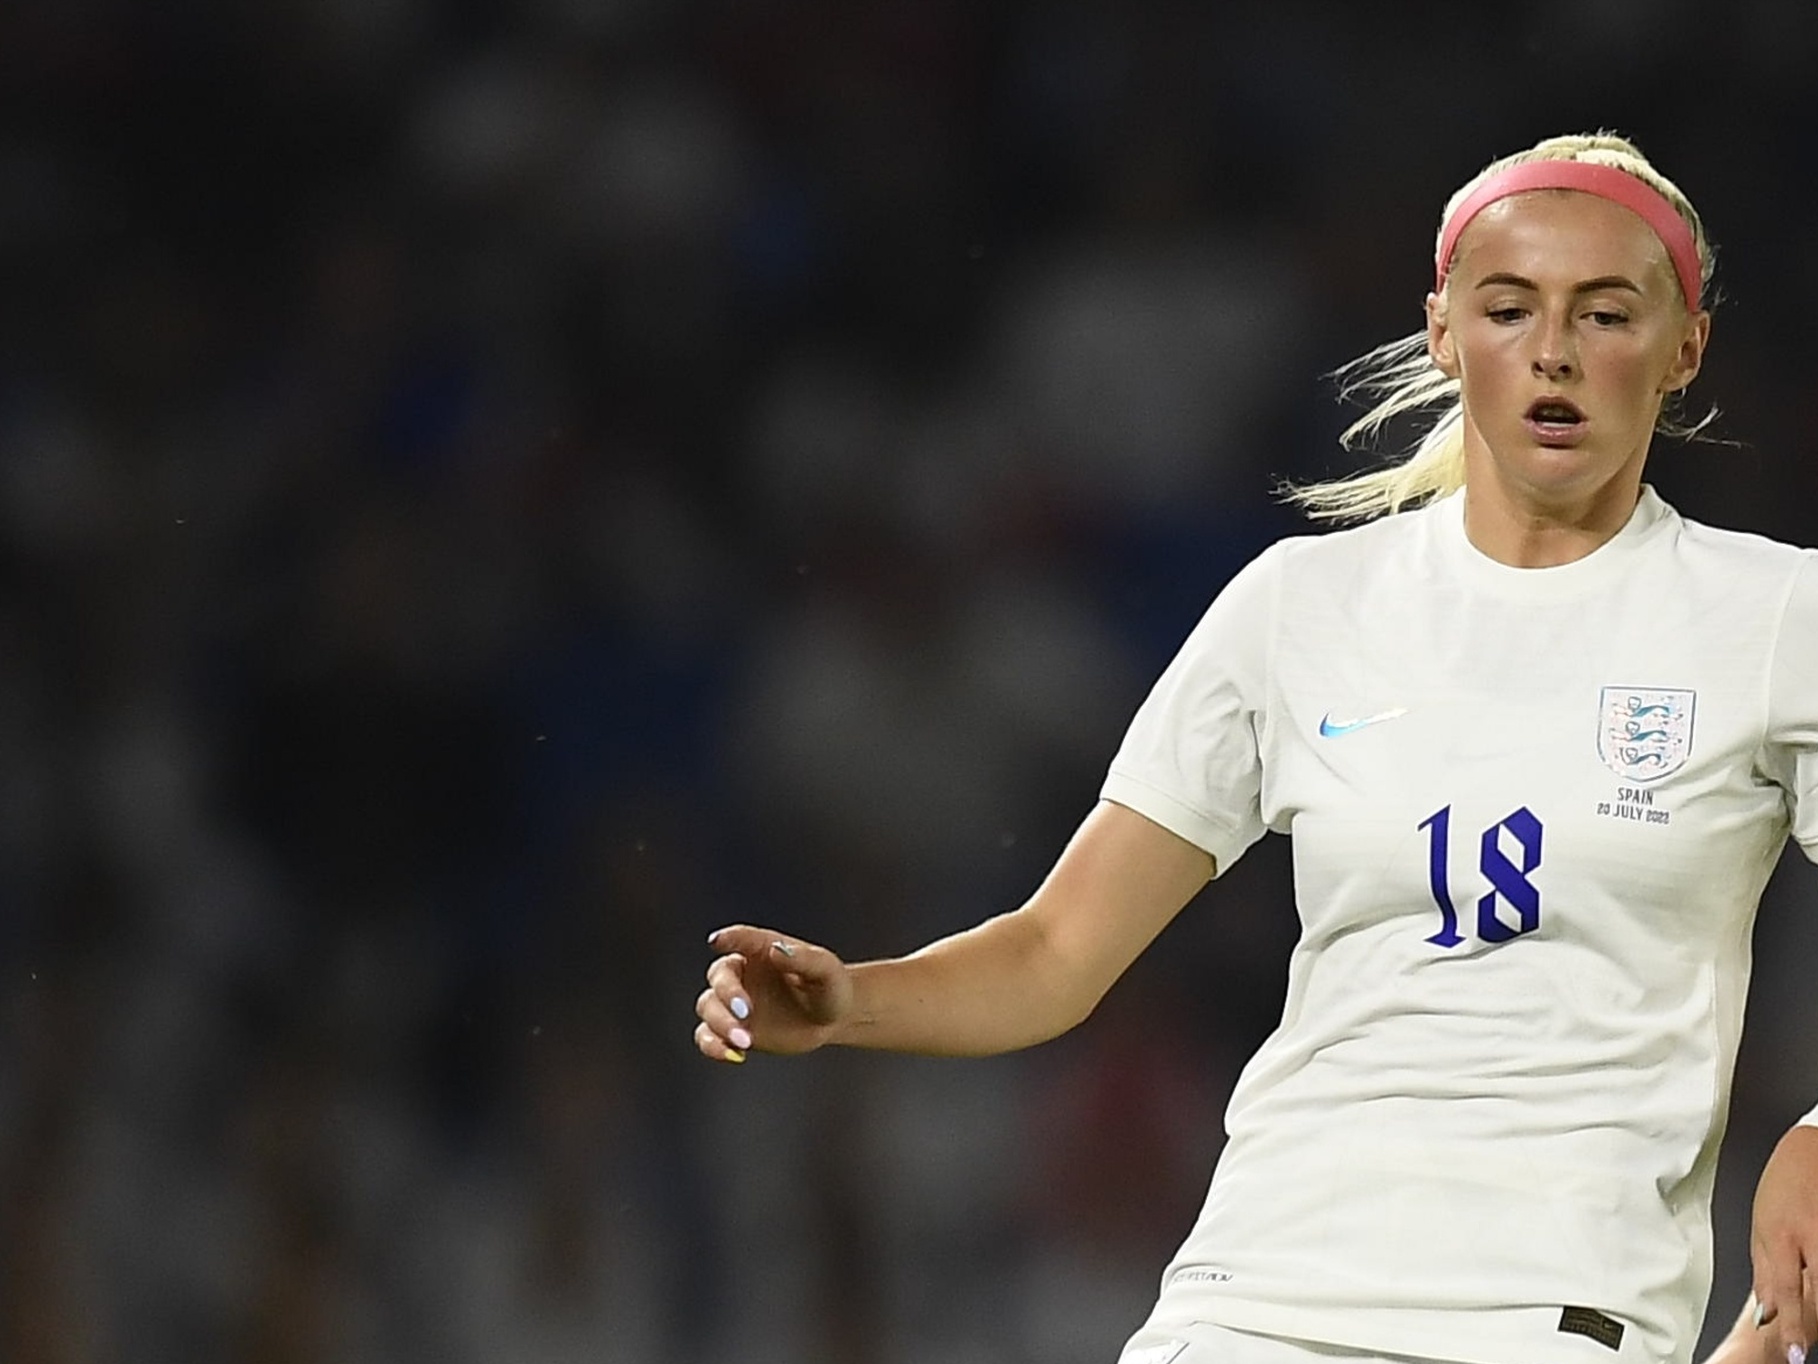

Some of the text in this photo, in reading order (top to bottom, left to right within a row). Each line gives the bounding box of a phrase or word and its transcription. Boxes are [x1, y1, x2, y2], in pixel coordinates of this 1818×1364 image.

[1617, 786, 1654, 805] SPAIN
[1597, 802, 1610, 815] 20
[1613, 804, 1643, 820] JULY
[1416, 804, 1544, 948] 18
